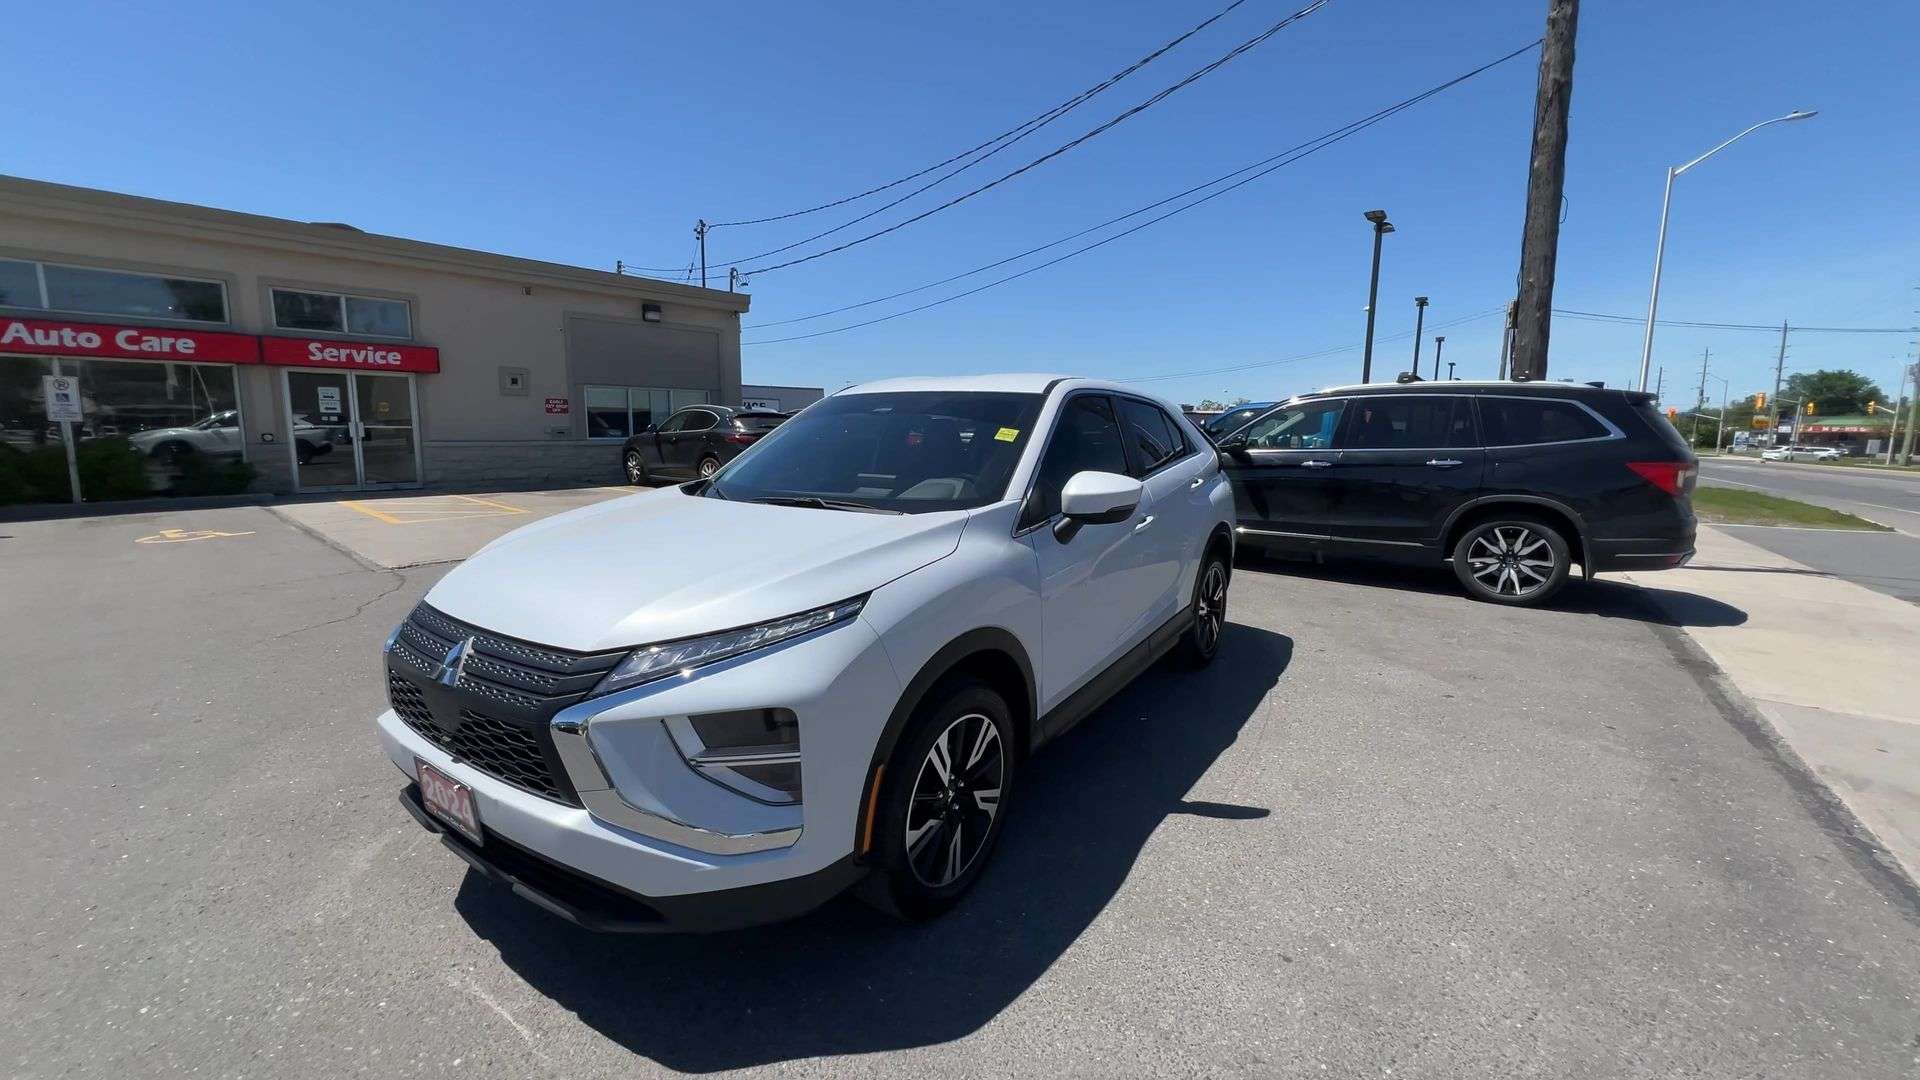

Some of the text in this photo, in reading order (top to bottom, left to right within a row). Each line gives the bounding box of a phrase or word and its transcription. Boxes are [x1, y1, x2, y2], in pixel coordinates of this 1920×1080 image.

[1, 322, 196, 354] Auto Care
[308, 342, 402, 365] Service
[421, 773, 477, 830] 2024
